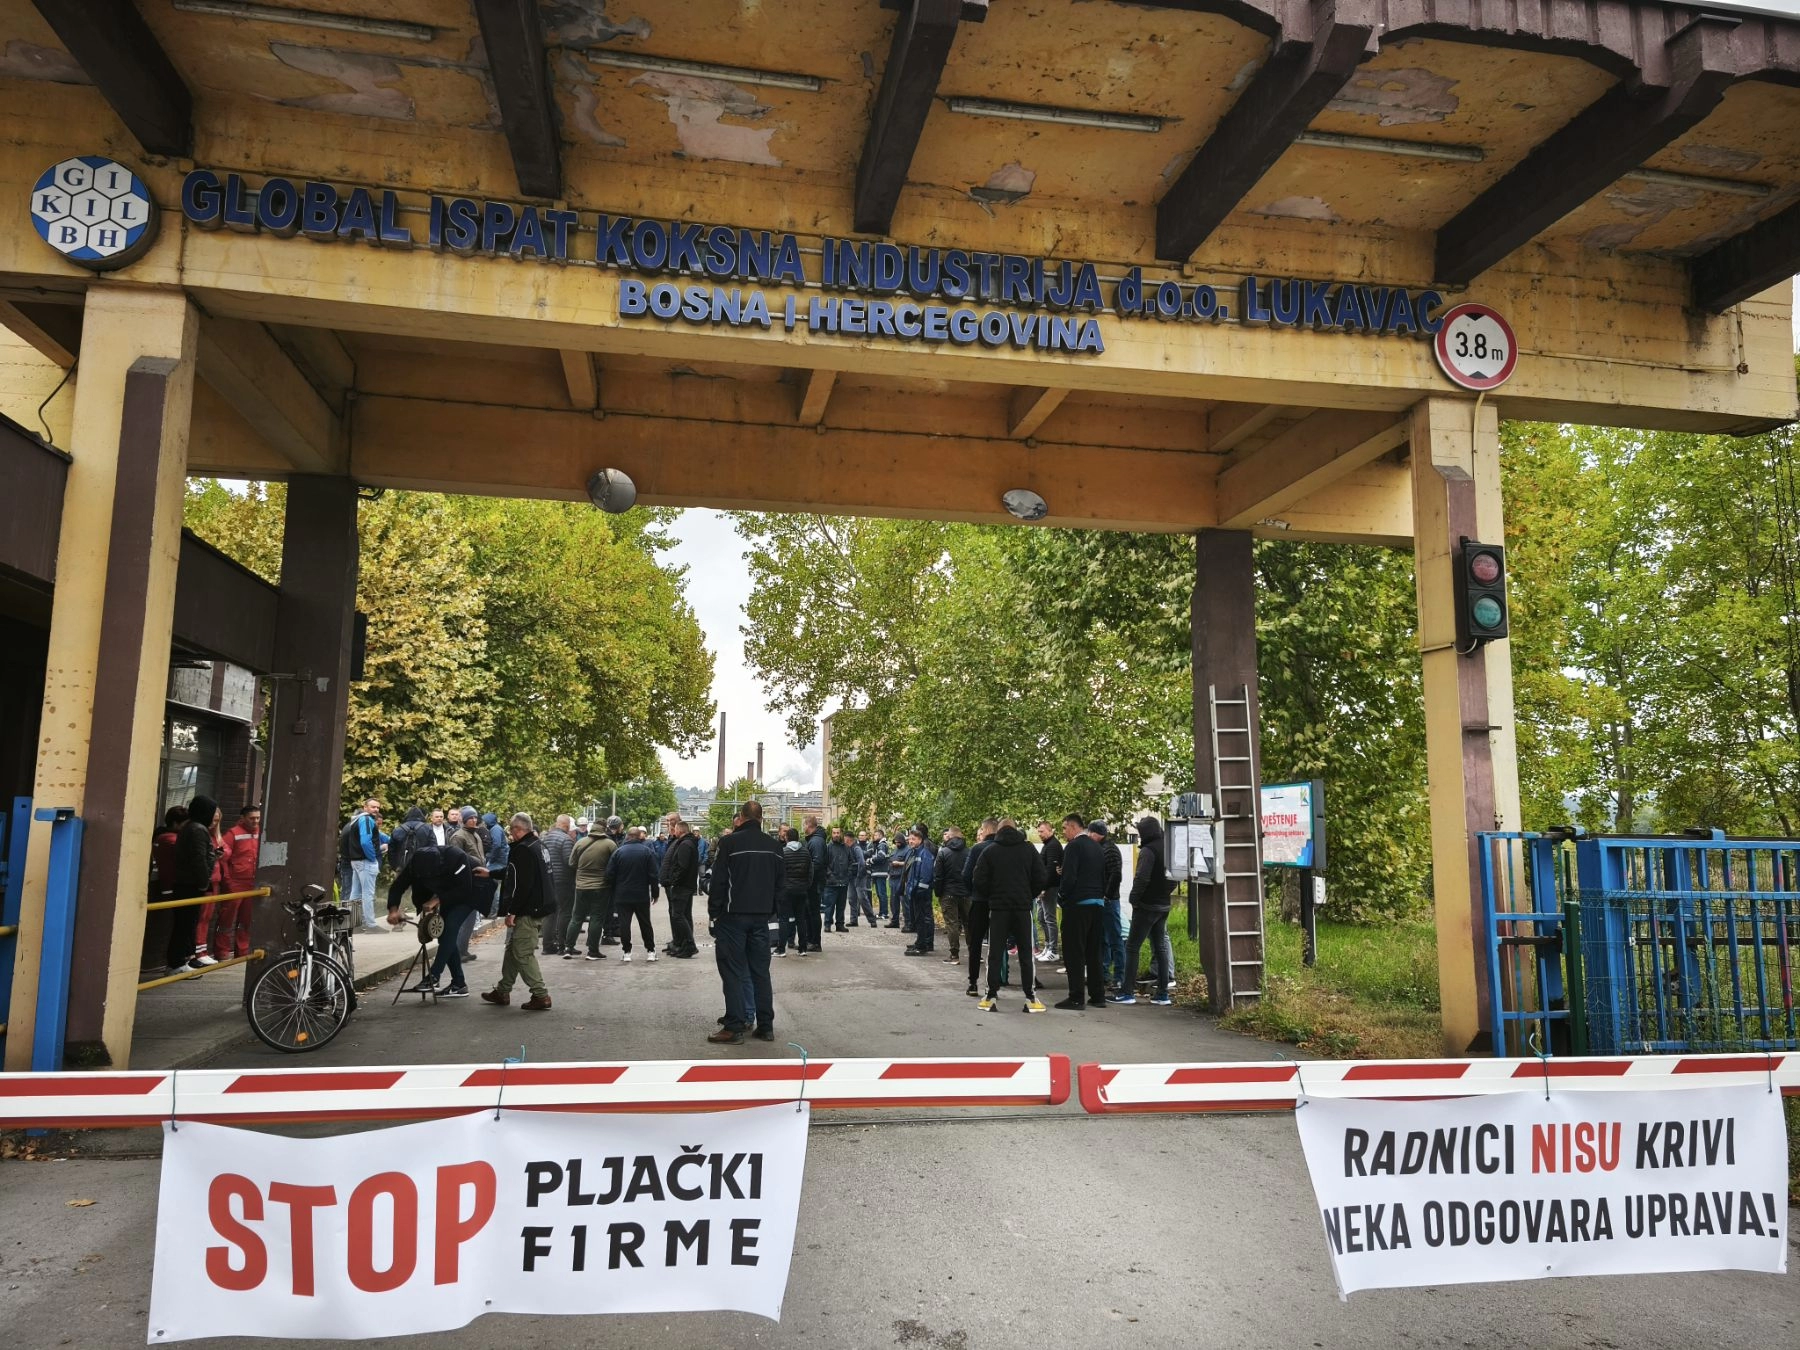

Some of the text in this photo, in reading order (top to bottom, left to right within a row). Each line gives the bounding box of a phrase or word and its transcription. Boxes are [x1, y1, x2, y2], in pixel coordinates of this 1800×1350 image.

[181, 168, 1446, 335] GLOBAL ISPAT KOKSNA INDUSTRIJA d.o.o. LUKAVAC
[618, 278, 1106, 353] BOSNA I HERCEGOVINA
[1455, 331, 1504, 361] 3.8 m
[523, 1144, 764, 1208] PLJAČKI
[1343, 1117, 1736, 1178] RADNICI NISU KRIVI
[205, 1160, 497, 1297] STOP
[521, 1218, 763, 1272] FIRME
[1322, 1191, 1781, 1256] NEKA ODGOVARA UPRAVA!
